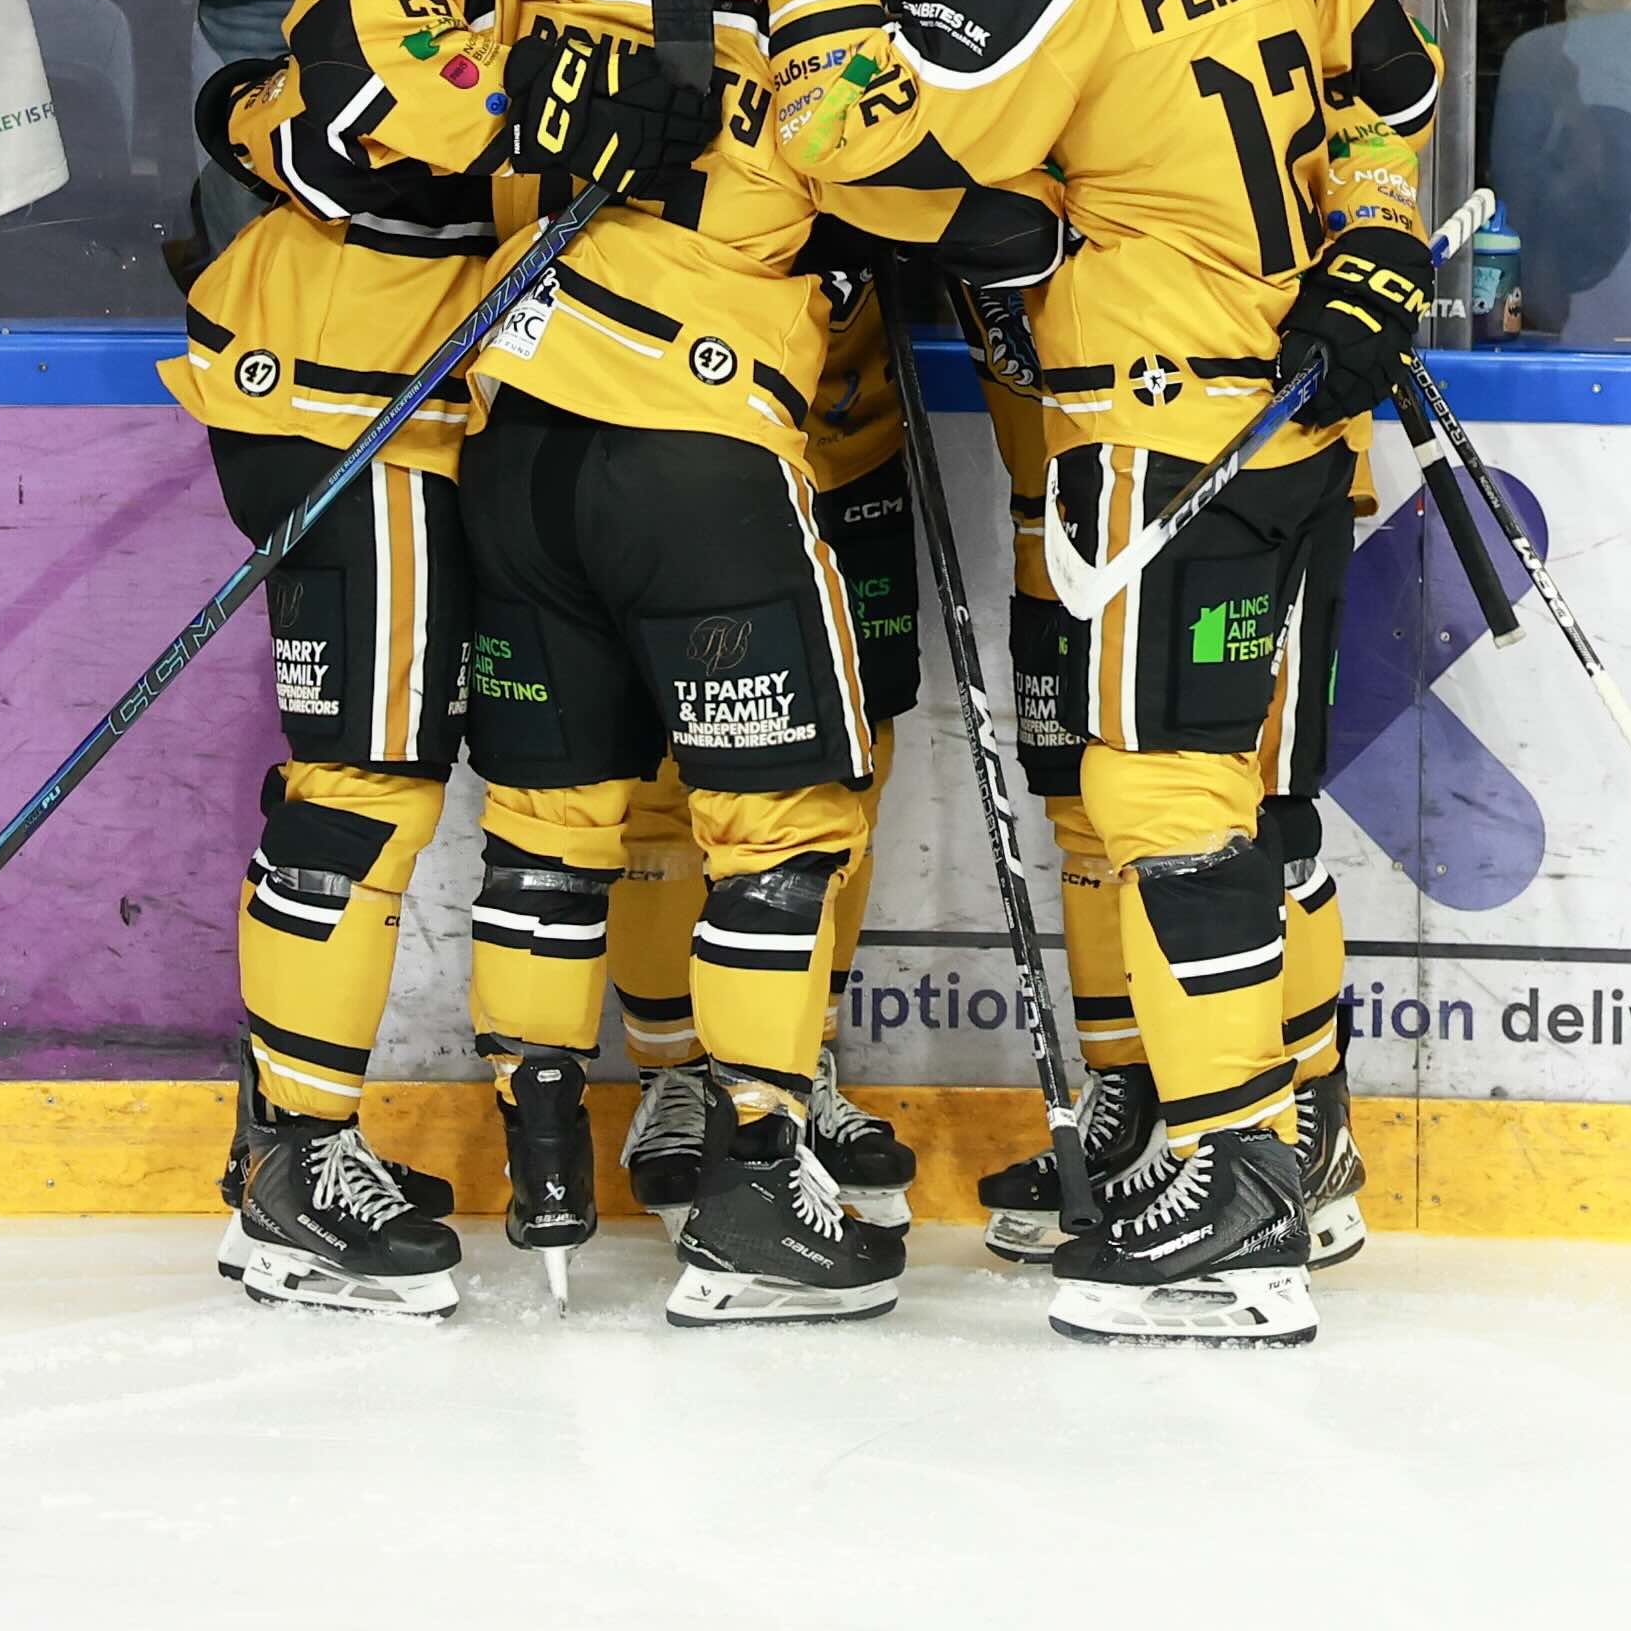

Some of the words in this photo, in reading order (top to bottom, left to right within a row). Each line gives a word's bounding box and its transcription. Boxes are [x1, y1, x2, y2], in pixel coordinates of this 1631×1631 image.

[963, 19, 992, 49] UK
[536, 36, 594, 156] CC
[779, 86, 824, 122] CARGO
[858, 63, 918, 129] 12
[25, 105, 42, 125] IS
[1192, 28, 1328, 276] 12
[1326, 253, 1432, 321] CCM
[1423, 298, 1467, 319] ITA
[504, 311, 545, 342] RC
[244, 360, 273, 386] 47
[697, 346, 729, 373] 47
[327, 429, 379, 485] SUPERCHARGED
[376, 416, 391, 434] MID
[389, 380, 424, 419] KICKPOINT
[1167, 451, 1241, 539] CCM
[843, 495, 905, 524] CCM
[852, 576, 892, 599] NCS
[1228, 594, 1271, 619] LINCS
[863, 614, 913, 639] STING
[1227, 620, 1257, 641] AIR
[275, 638, 328, 663] PARRY
[1226, 632, 1275, 662] TESTIN
[108, 592, 228, 739] CCM
[276, 662, 330, 687] FAMILY
[475, 653, 495, 676] AIR
[475, 672, 549, 703] TESTING
[673, 679, 698, 702] TJ
[703, 670, 791, 702] PARRY
[1024, 673, 1060, 698] PAR
[288, 698, 340, 716] DIRECTORS
[678, 702, 698, 722] &
[703, 692, 796, 723] FAMILY
[1024, 697, 1058, 720] FAM
[672, 730, 733, 749] FUNERAL
[733, 723, 818, 749] DIRECTORS
[687, 715, 792, 737] INDEPENDENT
[1061, 871, 1102, 889] CCM
[850, 967, 1031, 1044] iptio
[1340, 981, 1475, 1044] tion
